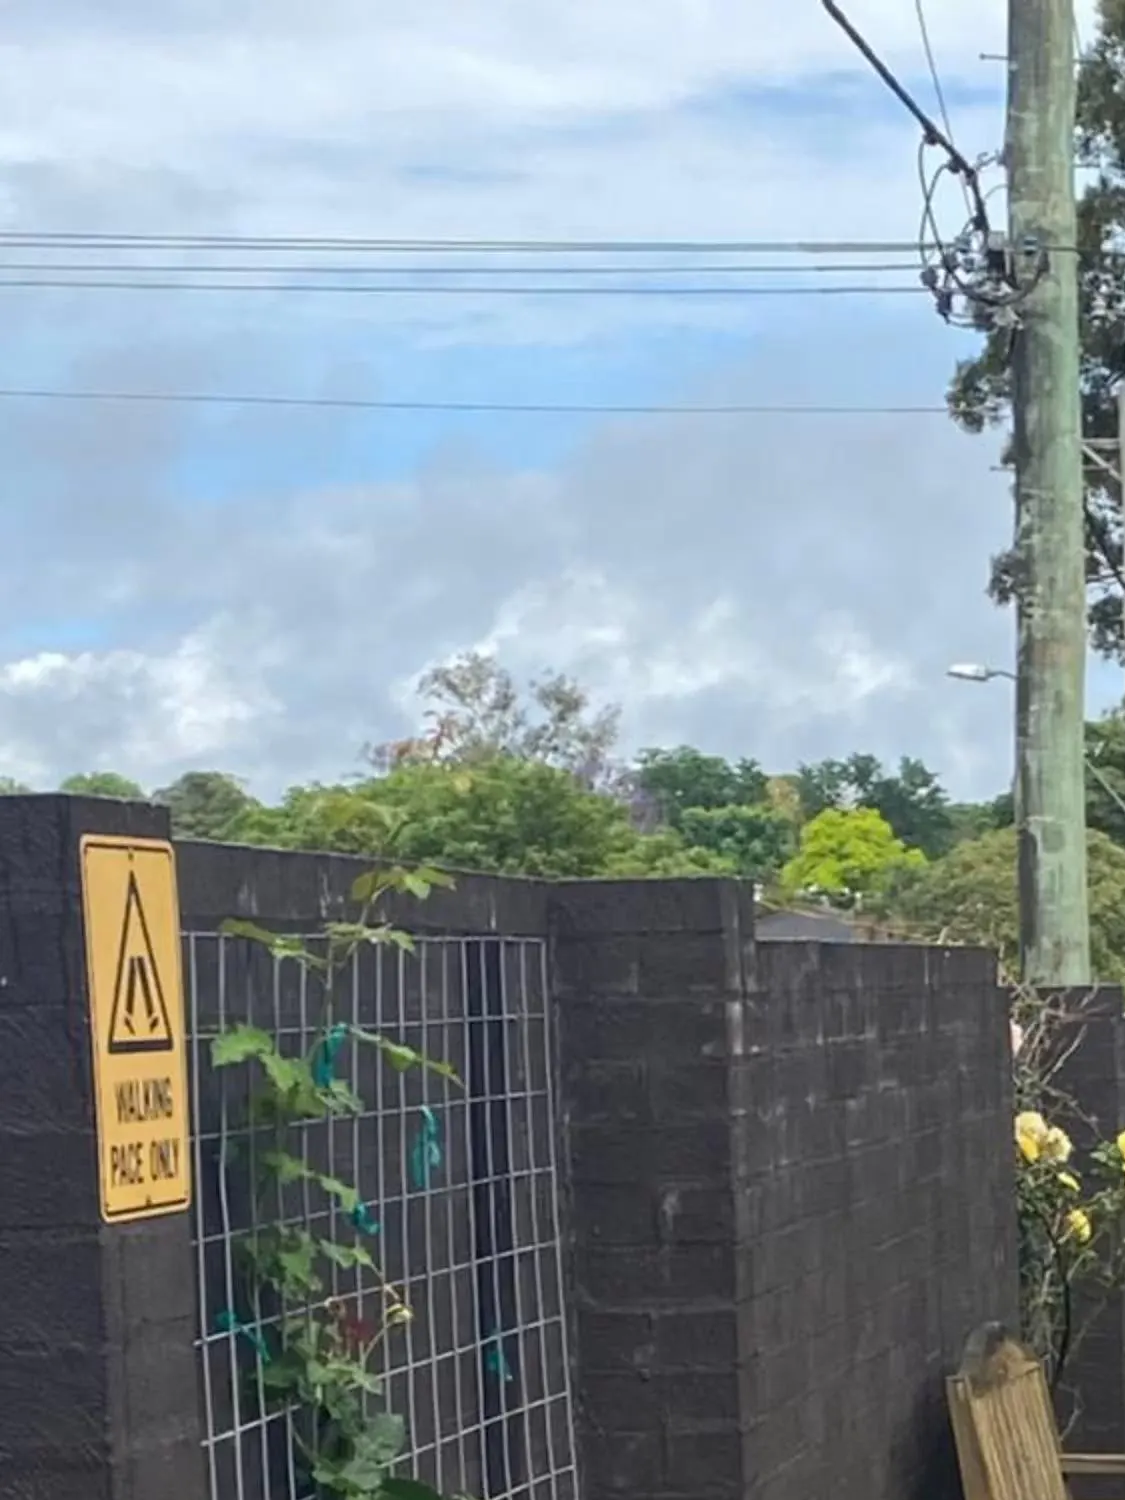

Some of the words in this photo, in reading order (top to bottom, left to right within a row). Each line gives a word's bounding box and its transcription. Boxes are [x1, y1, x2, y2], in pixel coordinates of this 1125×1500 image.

[114, 1077, 173, 1124] WALKING
[110, 1142, 144, 1188] PACE
[150, 1137, 180, 1182] ONLY
